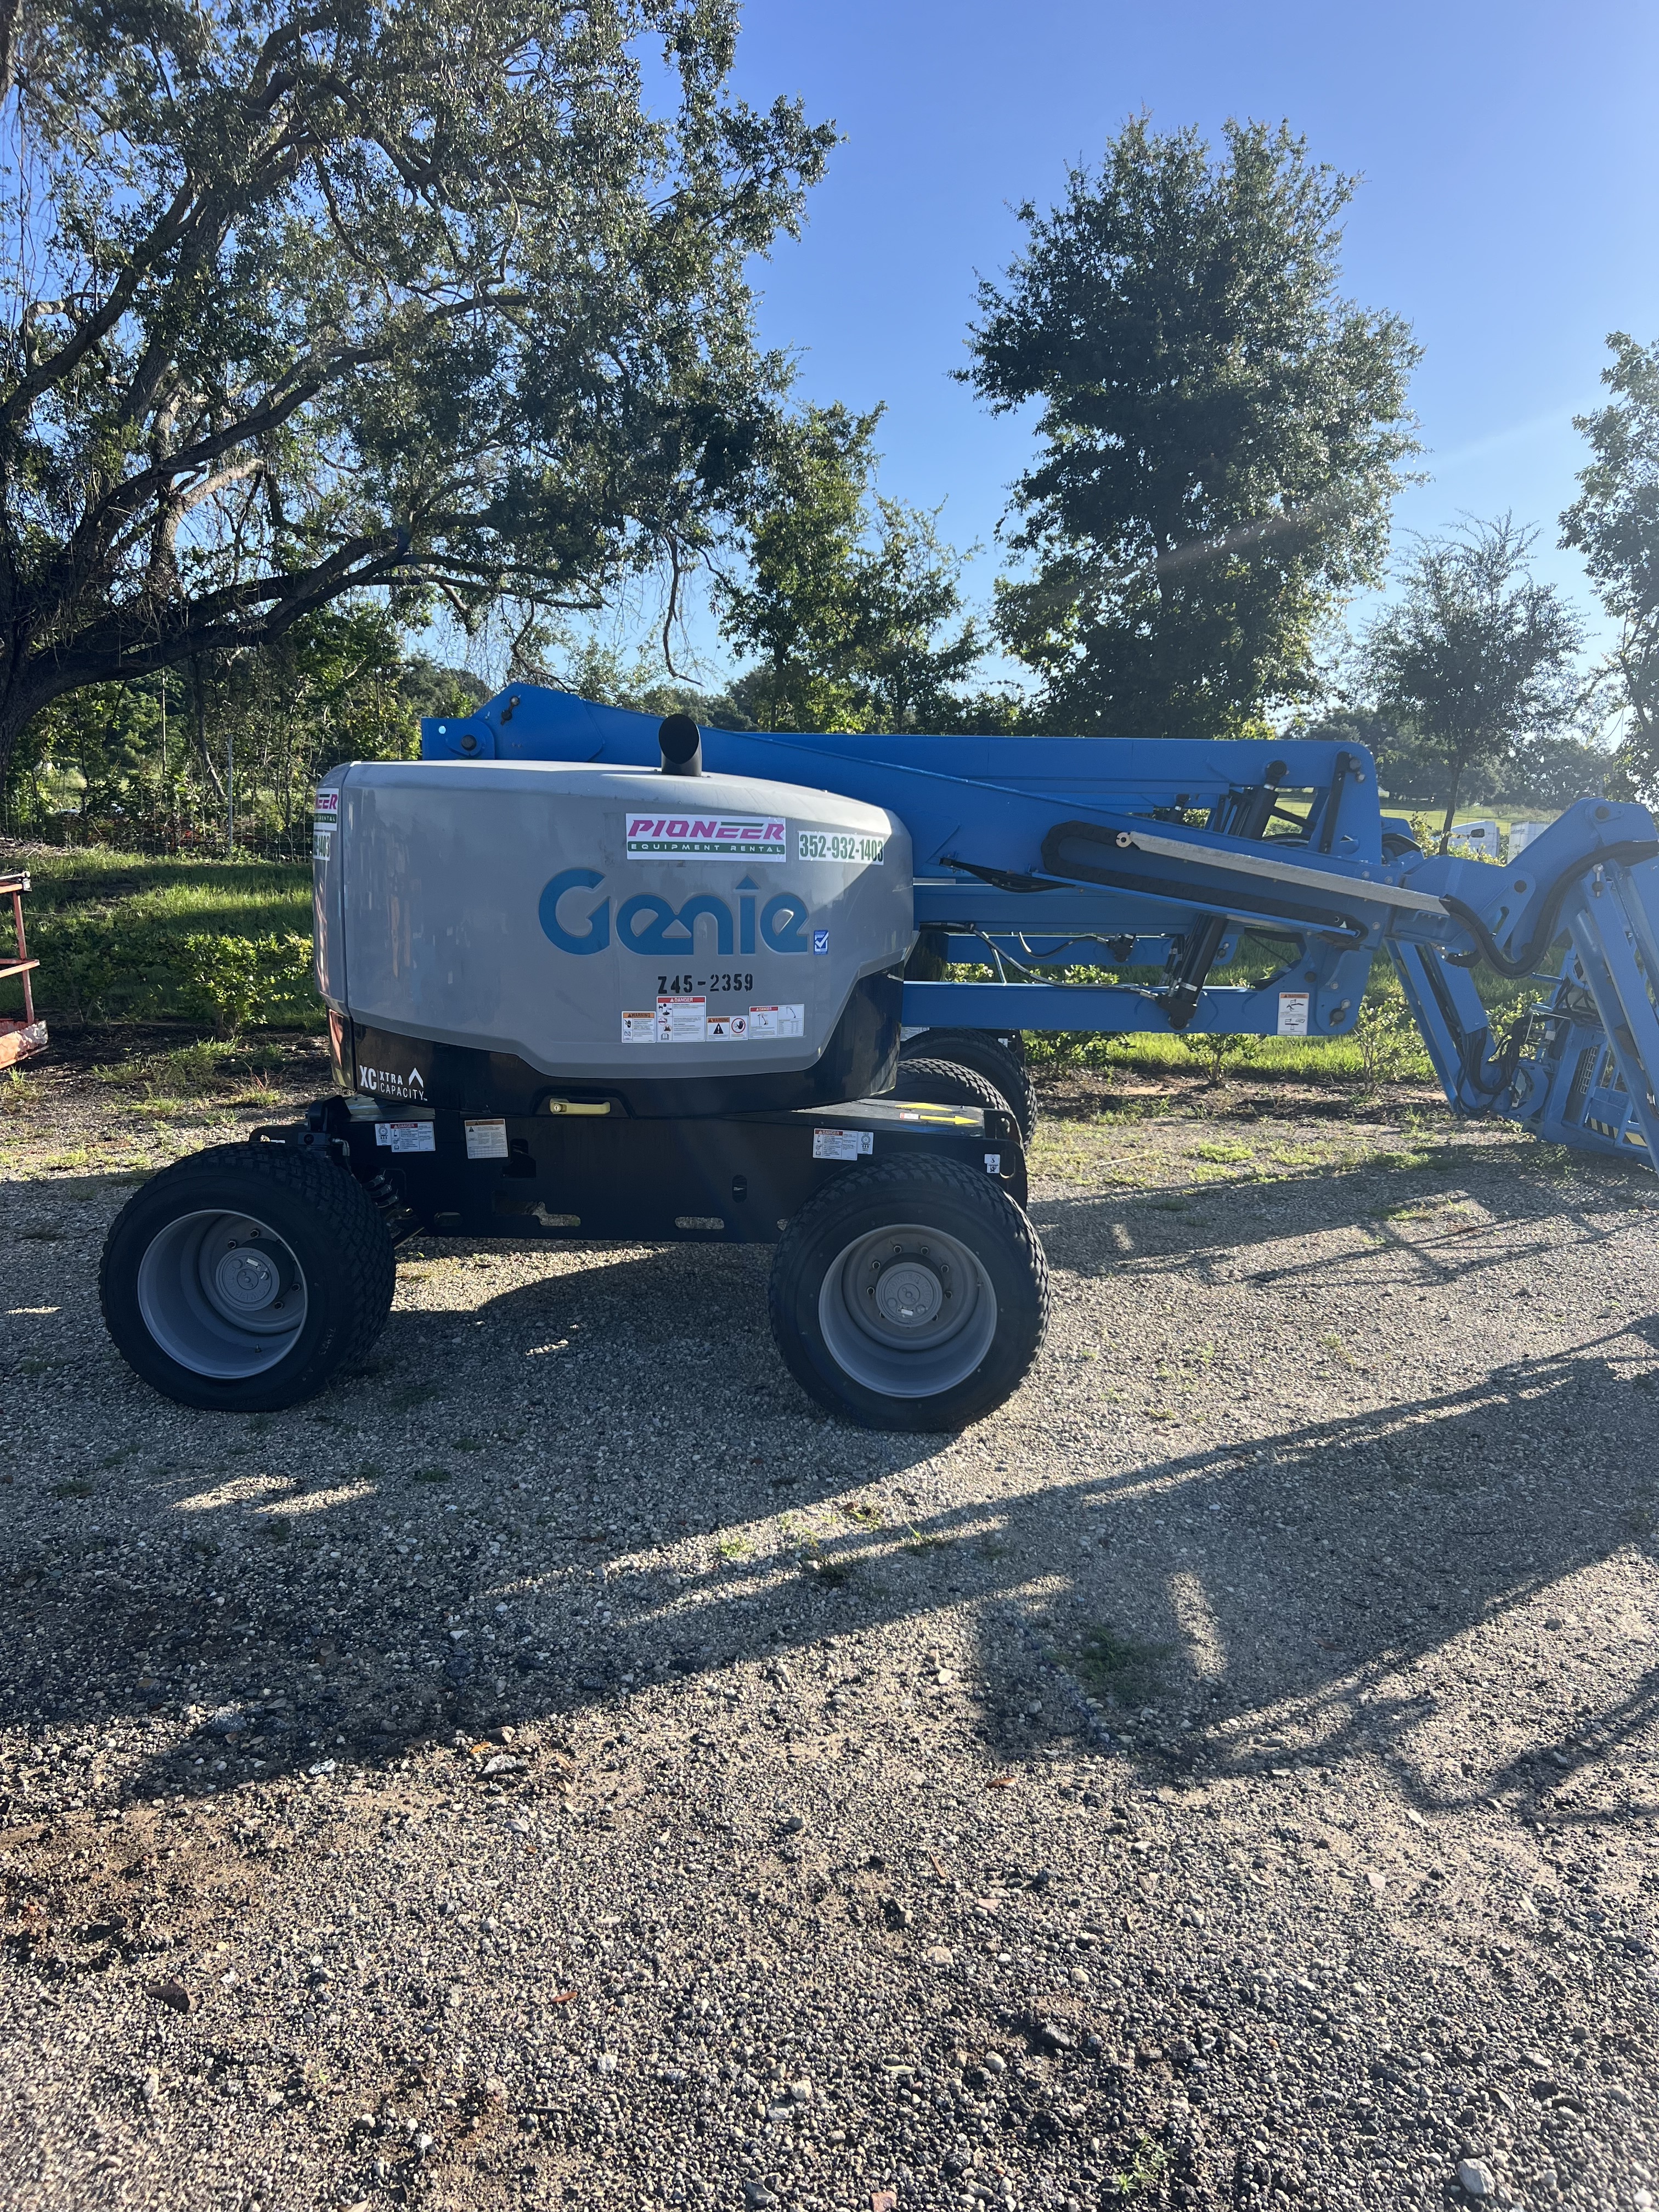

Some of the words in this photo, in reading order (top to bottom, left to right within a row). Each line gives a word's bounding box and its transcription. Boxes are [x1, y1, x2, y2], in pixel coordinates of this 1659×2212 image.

[628, 820, 785, 840] PIONEER
[799, 834, 883, 862] 352-932-1403
[538, 867, 809, 956] Genie
[658, 973, 754, 994] Z45-2359
[359, 1065, 377, 1090] XC
[380, 1070, 403, 1085] XTRA
[380, 1082, 424, 1101] CAPACITY
[887, 1273, 921, 1295] POWER
